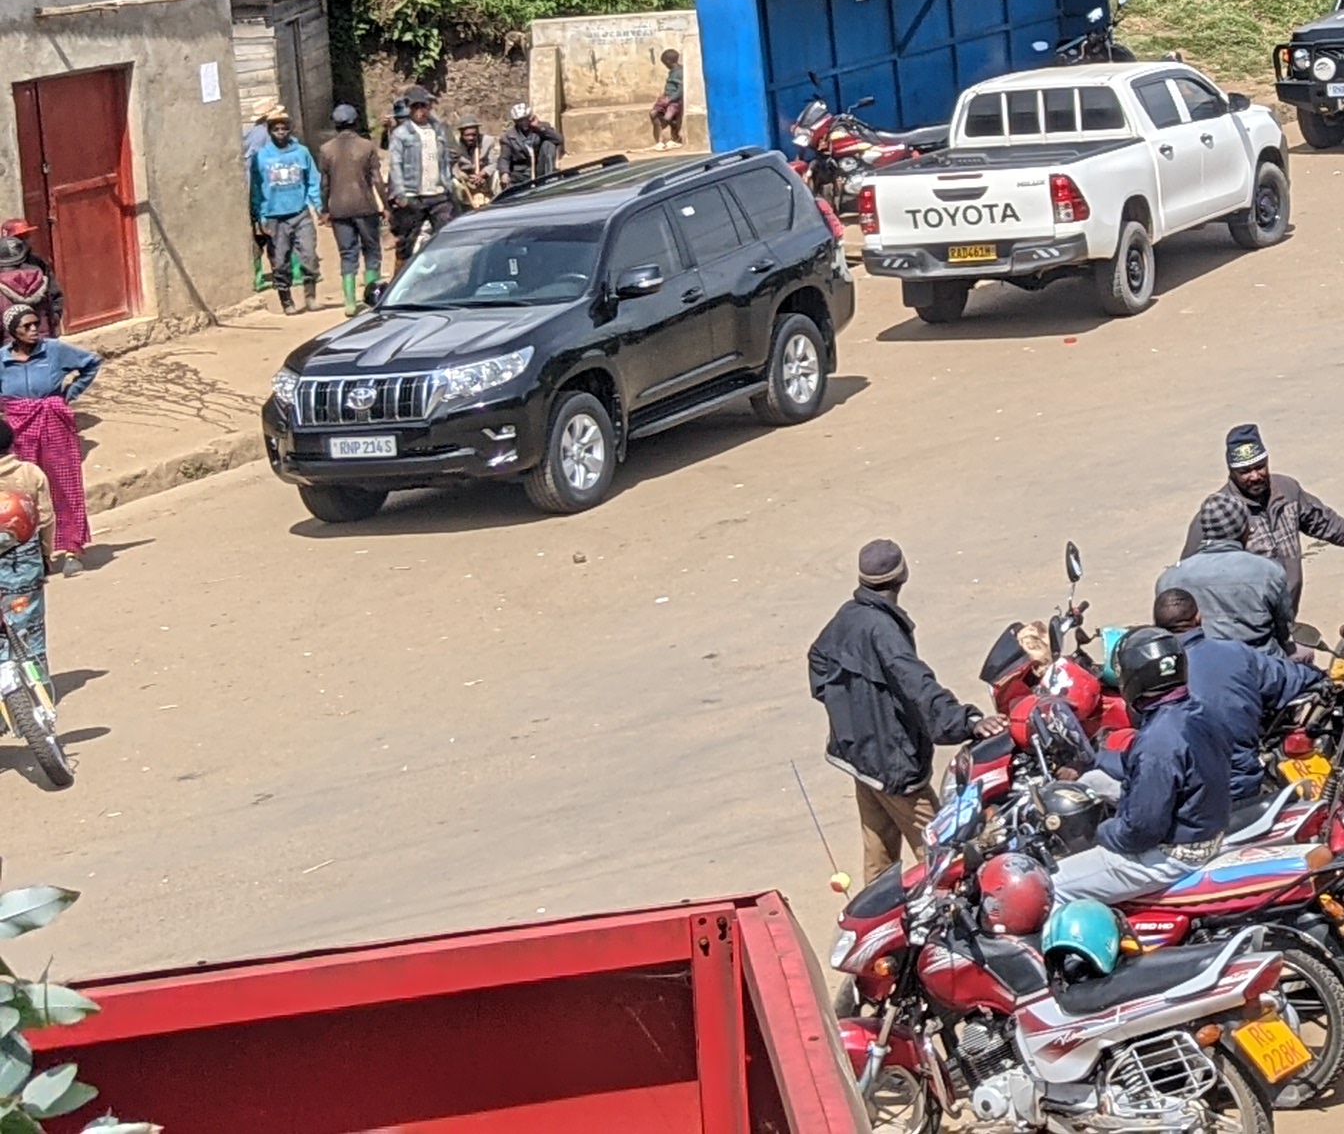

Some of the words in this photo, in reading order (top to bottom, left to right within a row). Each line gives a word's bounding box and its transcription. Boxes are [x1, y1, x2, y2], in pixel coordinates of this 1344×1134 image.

[905, 202, 1021, 230] TOYOTA
[339, 439, 361, 454] RNP
[362, 438, 384, 454] 214
[385, 438, 392, 453] S
[1157, 922, 1175, 930] HD
[1247, 1023, 1276, 1049] RG
[1262, 1038, 1305, 1076] 228K
